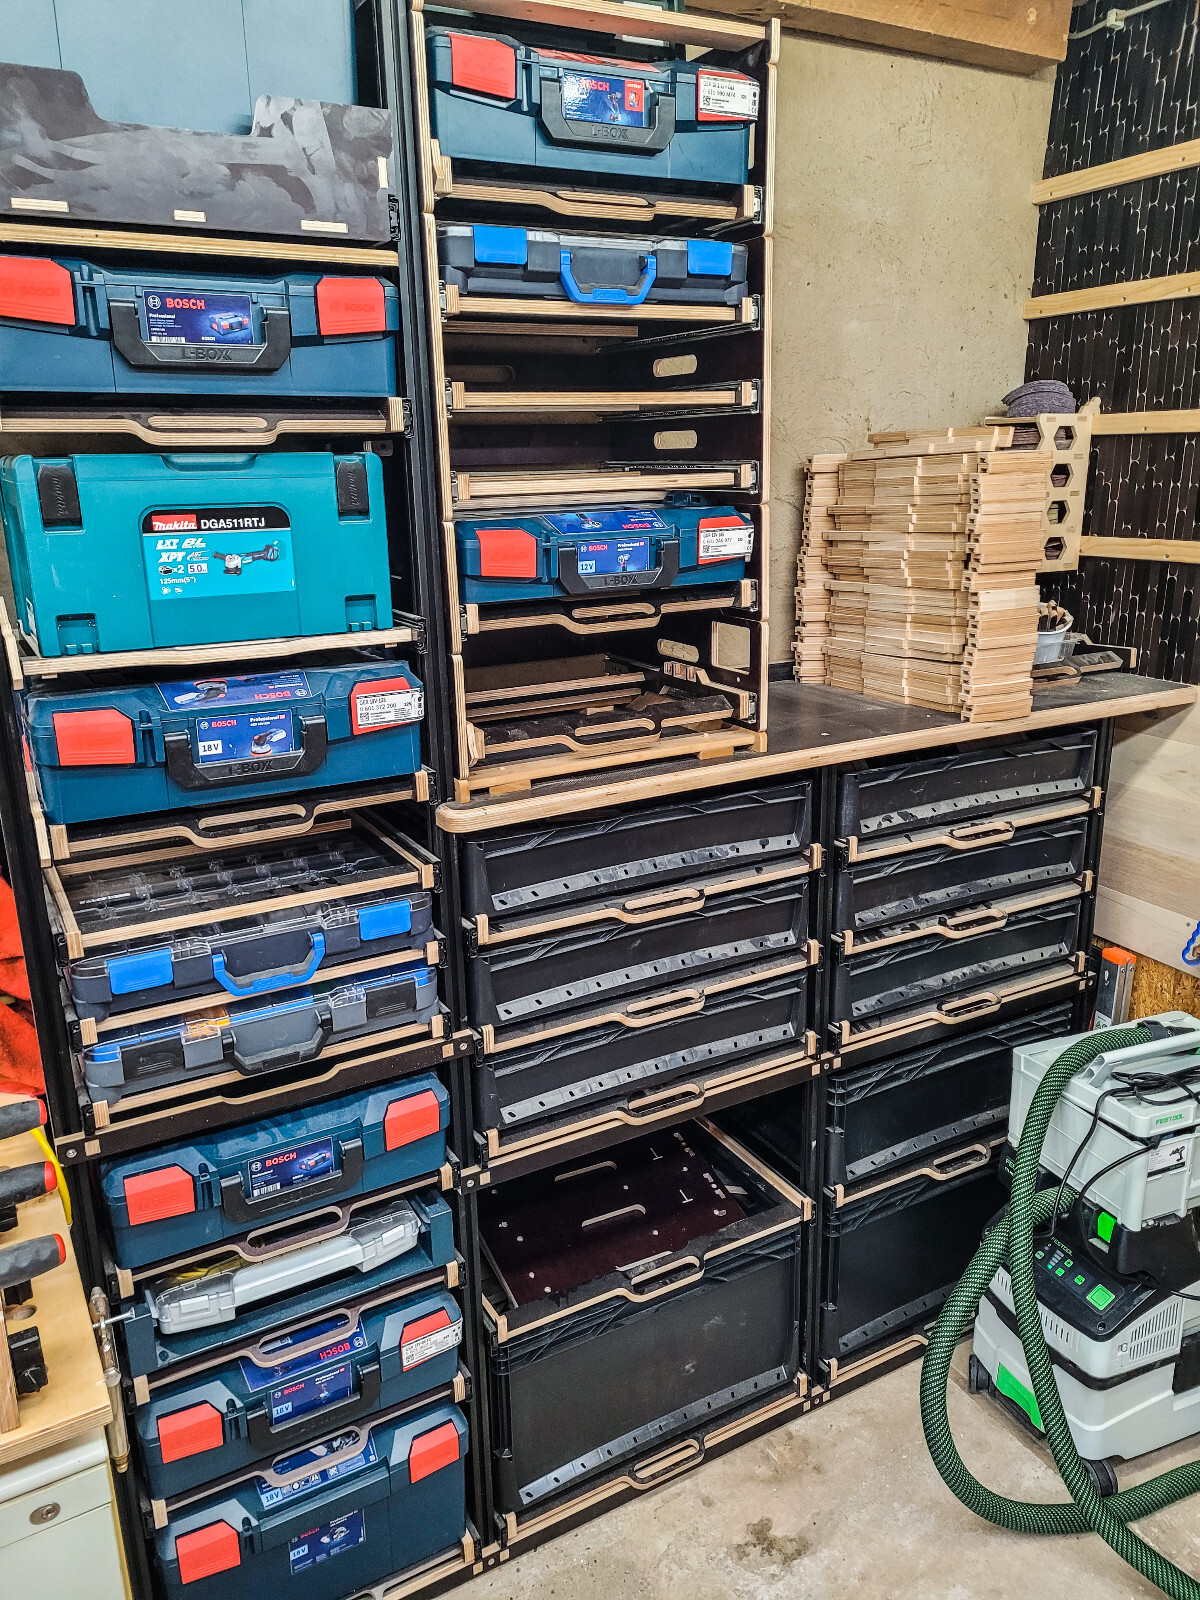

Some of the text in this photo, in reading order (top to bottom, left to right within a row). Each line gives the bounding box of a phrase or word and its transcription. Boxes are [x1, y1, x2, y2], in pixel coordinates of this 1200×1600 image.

[165, 297, 206, 310] BOSCH
[200, 517, 266, 530] DGA511RTJ
[588, 544, 608, 552] BOSCH
[158, 551, 187, 563] XPT
[254, 690, 291, 700] BOSCH
[211, 719, 237, 728] BOSCH
[249, 714, 280, 722] Professional
[1155, 1113, 1185, 1126] FESTOOL
[265, 1151, 297, 1167] BOSCH
[1050, 1236, 1073, 1257] FESTOOL
[319, 1342, 352, 1360] BOSCH
[283, 1383, 305, 1396] BOSCH
[265, 1492, 280, 1503] 18V
